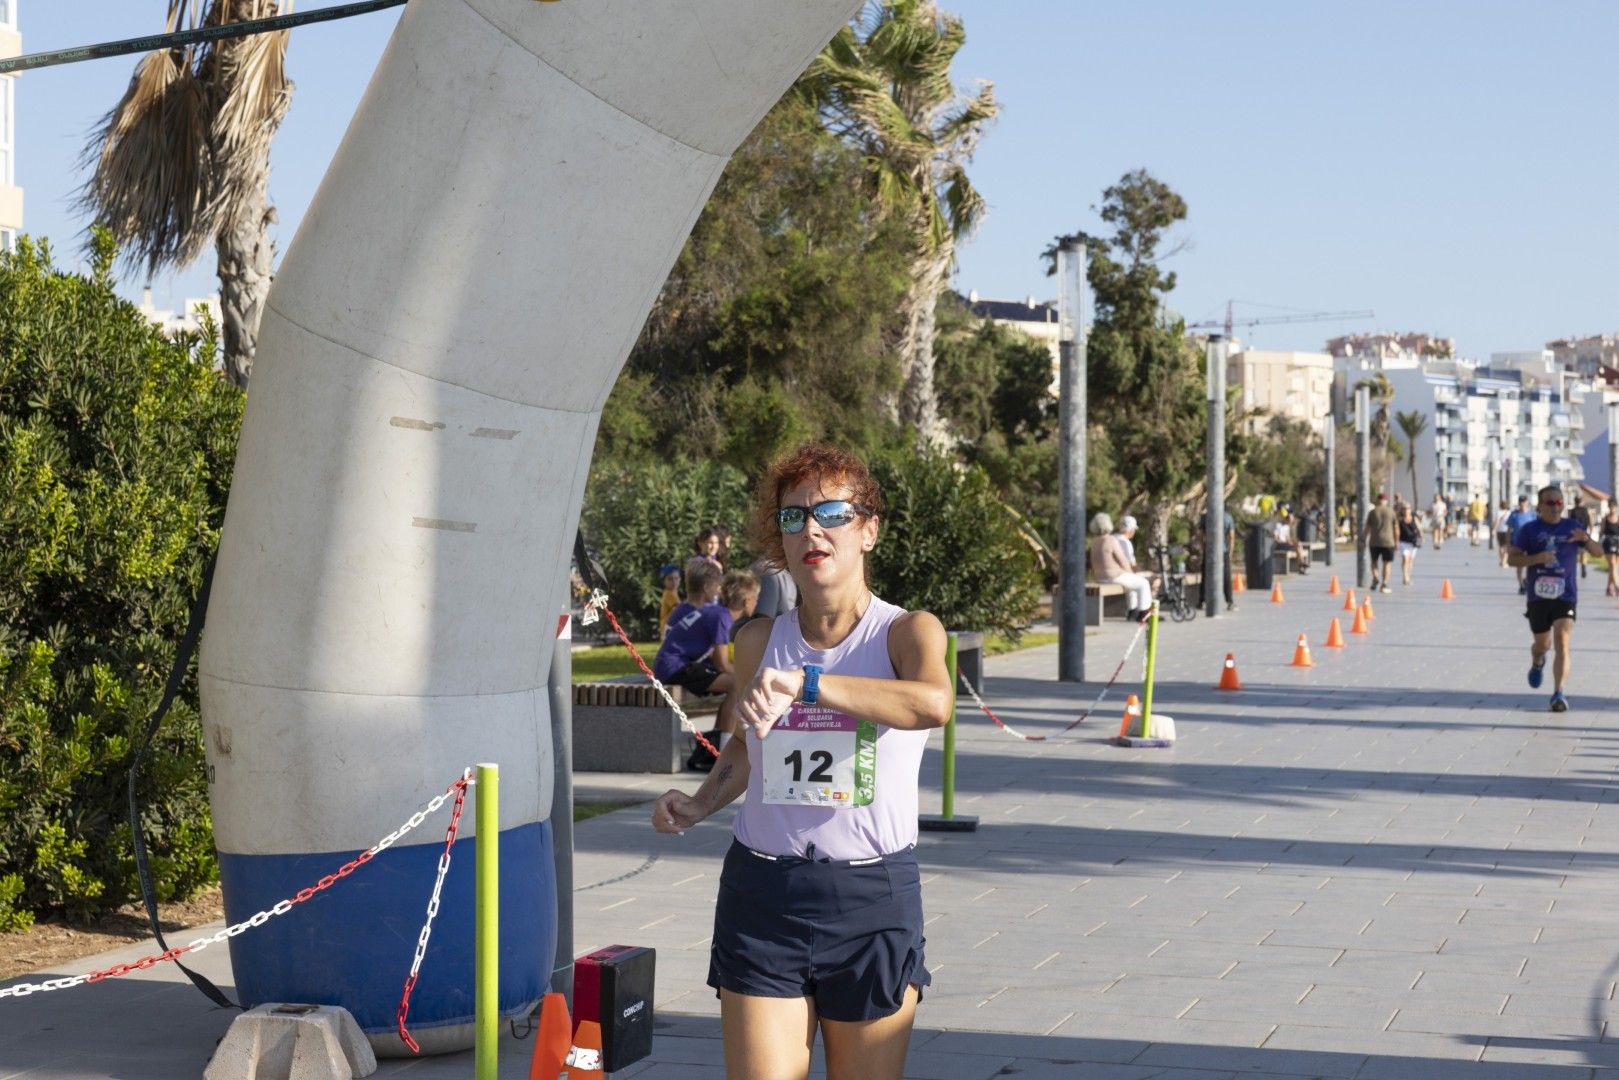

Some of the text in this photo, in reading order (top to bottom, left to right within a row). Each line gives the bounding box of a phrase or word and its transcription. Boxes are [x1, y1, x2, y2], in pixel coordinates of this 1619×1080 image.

[784, 750, 833, 782] 12
[859, 740, 875, 800] 3,5 KM
